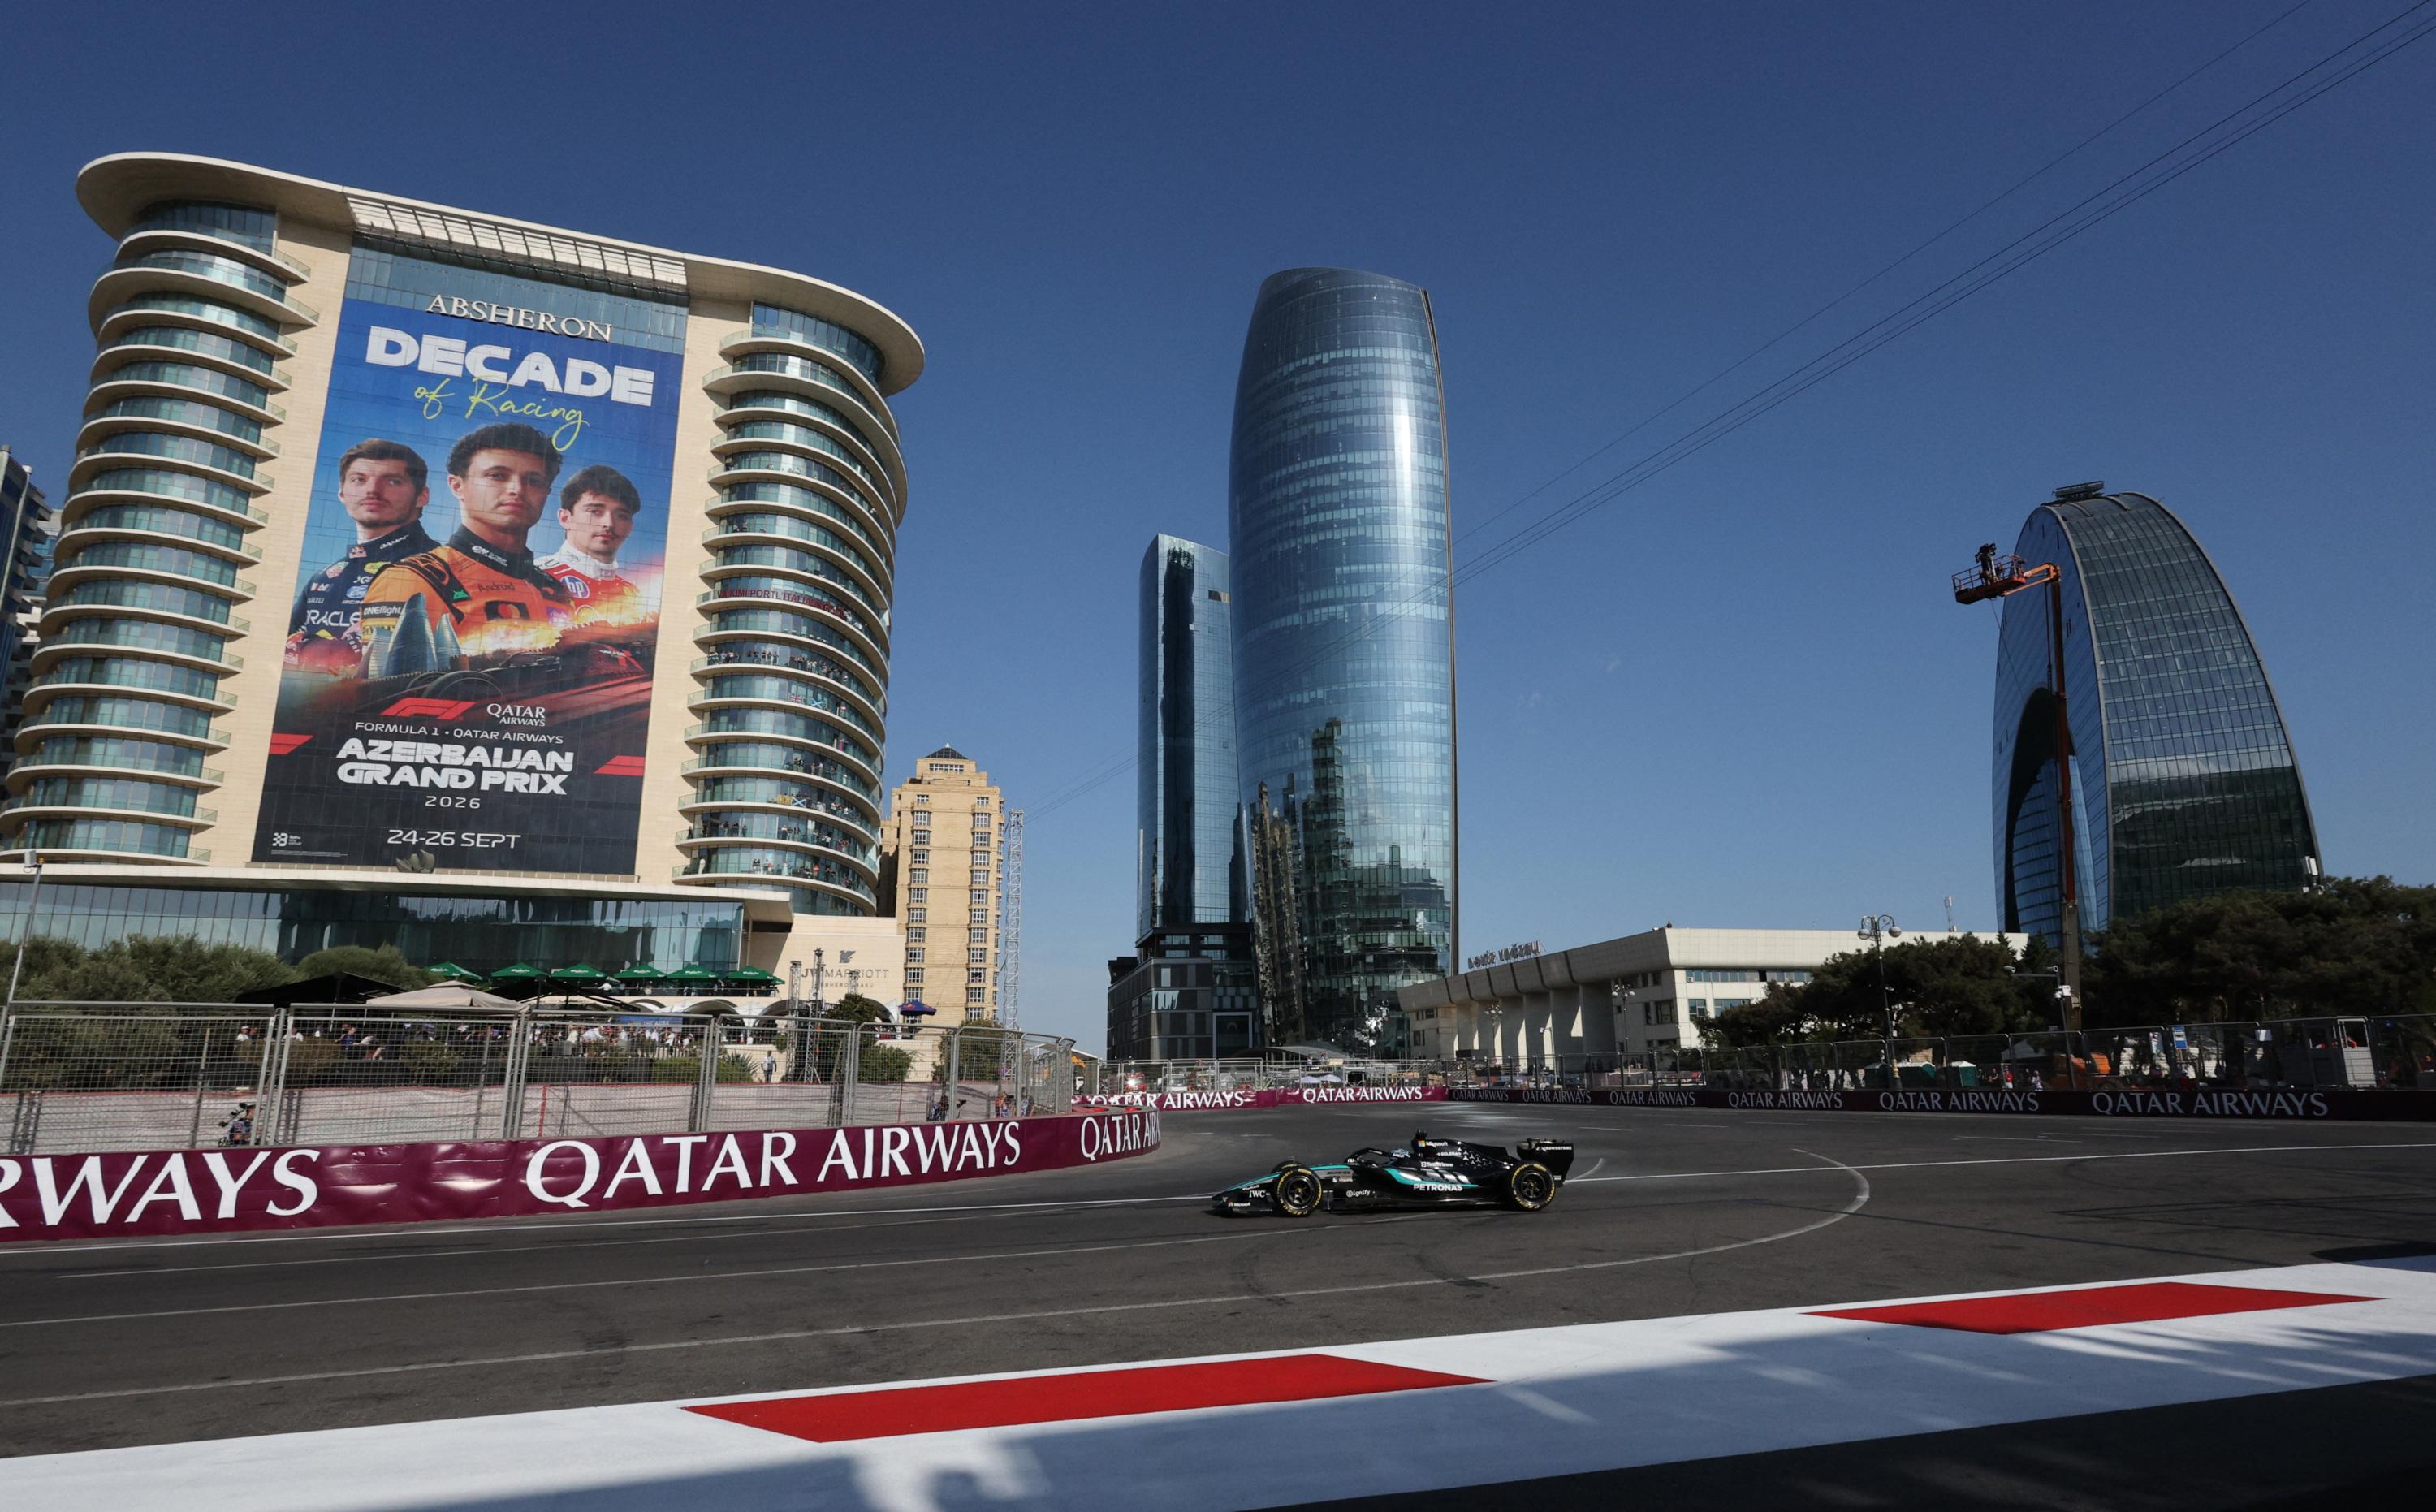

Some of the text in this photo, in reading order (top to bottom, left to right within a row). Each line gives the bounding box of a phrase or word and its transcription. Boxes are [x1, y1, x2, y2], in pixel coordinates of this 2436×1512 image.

[426, 294, 612, 343] ABSHERON
[365, 326, 654, 407] DECADE
[414, 375, 590, 451] of Racing
[477, 582, 516, 592] Android
[487, 703, 546, 719] QATAR
[499, 716, 546, 727] AIRWAYS
[355, 722, 564, 744] FORMULA 1 QATAR AIRWAYS
[335, 737, 574, 772] AZERBAIJAN
[336, 762, 568, 795] GRAND PRIX
[425, 795, 481, 810] 2026
[387, 829, 522, 849] 24-26 SEPT
[1163, 1091, 1244, 1109] AIRWAYS
[1303, 1086, 1423, 1103] QATAR AIRWAYS
[1452, 1090, 1509, 1102] QATAR AIRWAYS
[1522, 1090, 1592, 1104] QATAR AIRWAYS
[1609, 1091, 1696, 1106] QATAR AIRWAYS
[1728, 1091, 1843, 1108] QATAR AIRWAYS
[1879, 1092, 2040, 1112] QATAR AIRWAYS
[2092, 1092, 2330, 1117] QATAR AIRWAYS
[1081, 1111, 1161, 1161] QATAR AIR
[526, 1121, 1021, 1208] QATAR AIRWAYS
[1249, 1190, 1266, 1198] IWC
[1413, 1184, 1462, 1192] PETRONAS
